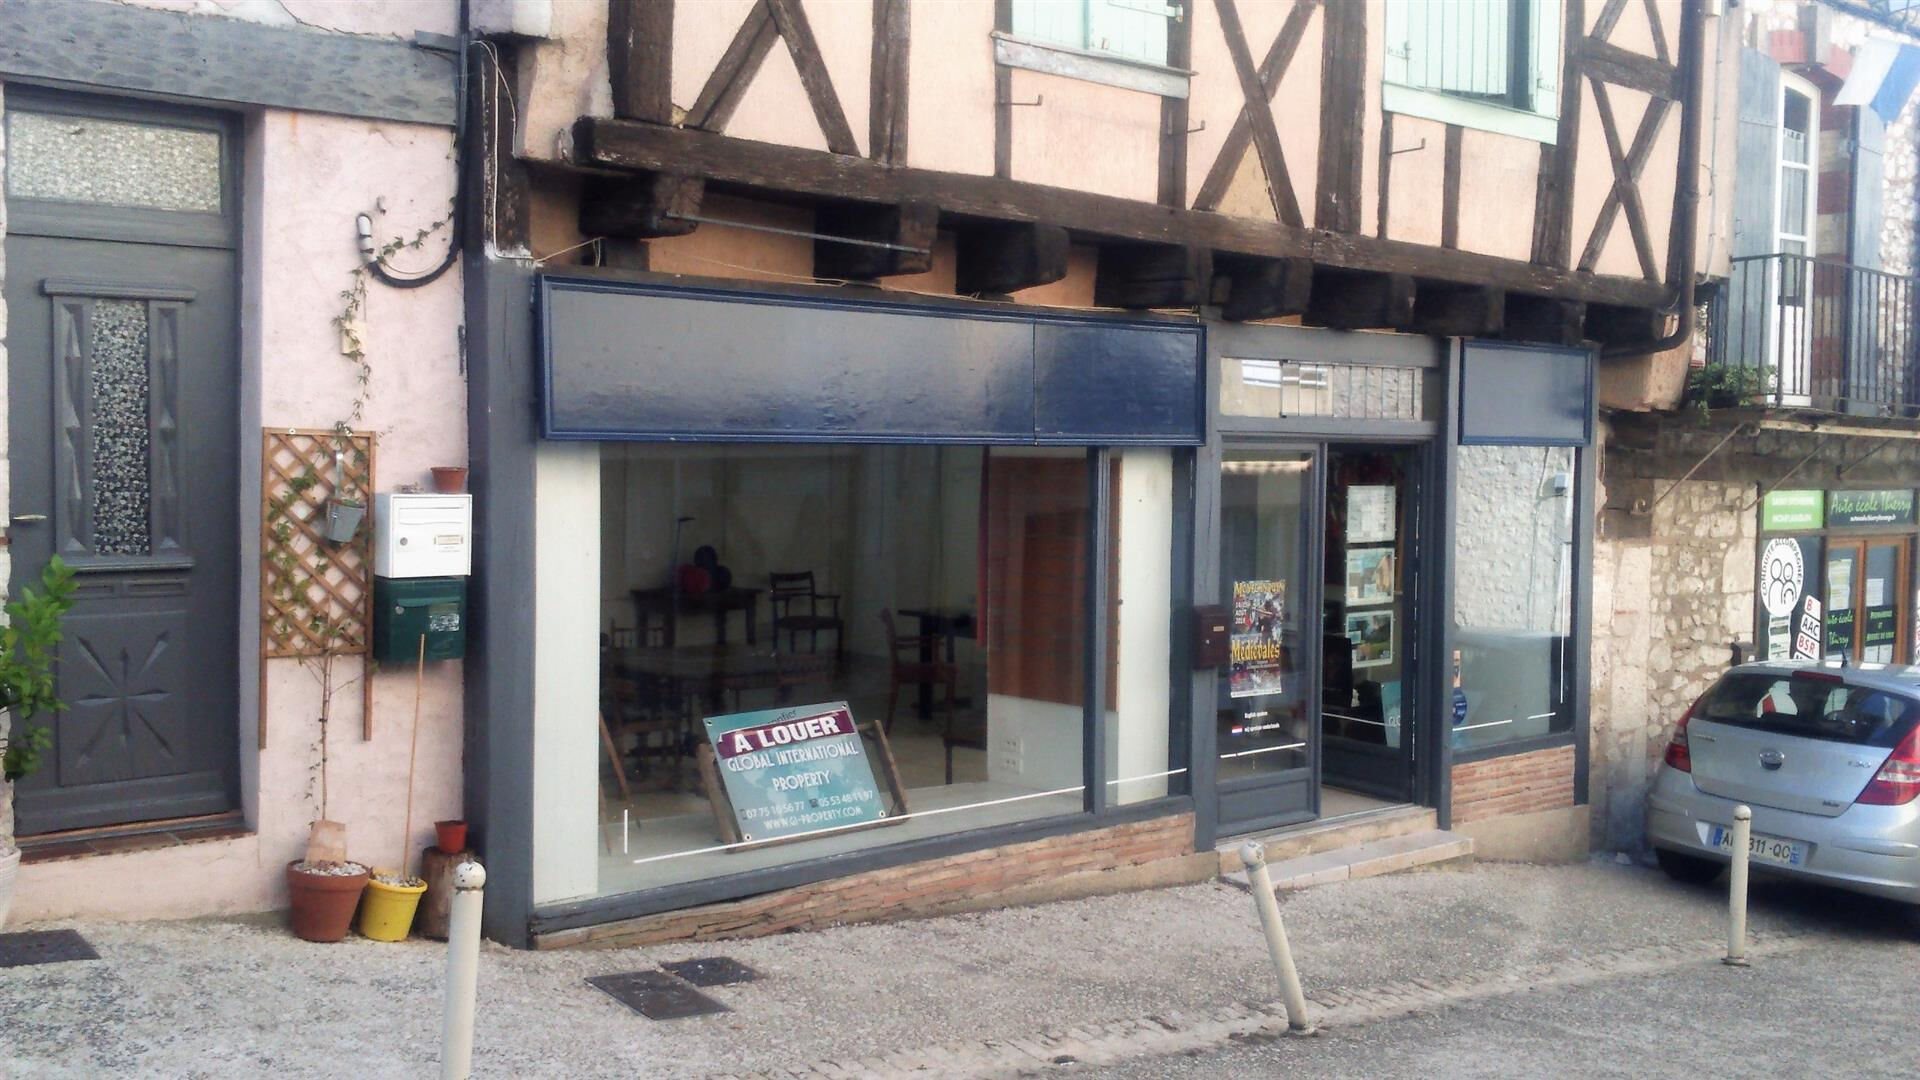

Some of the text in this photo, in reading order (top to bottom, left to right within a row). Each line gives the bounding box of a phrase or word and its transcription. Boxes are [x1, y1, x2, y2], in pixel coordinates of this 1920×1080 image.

[1802, 617, 1819, 636] AAC
[1798, 635, 1816, 655] BSR
[734, 716, 840, 753] A LOUER
[727, 741, 859, 772] GLOBAL INTERNATIONAL
[772, 770, 832, 792] PROPERTY
